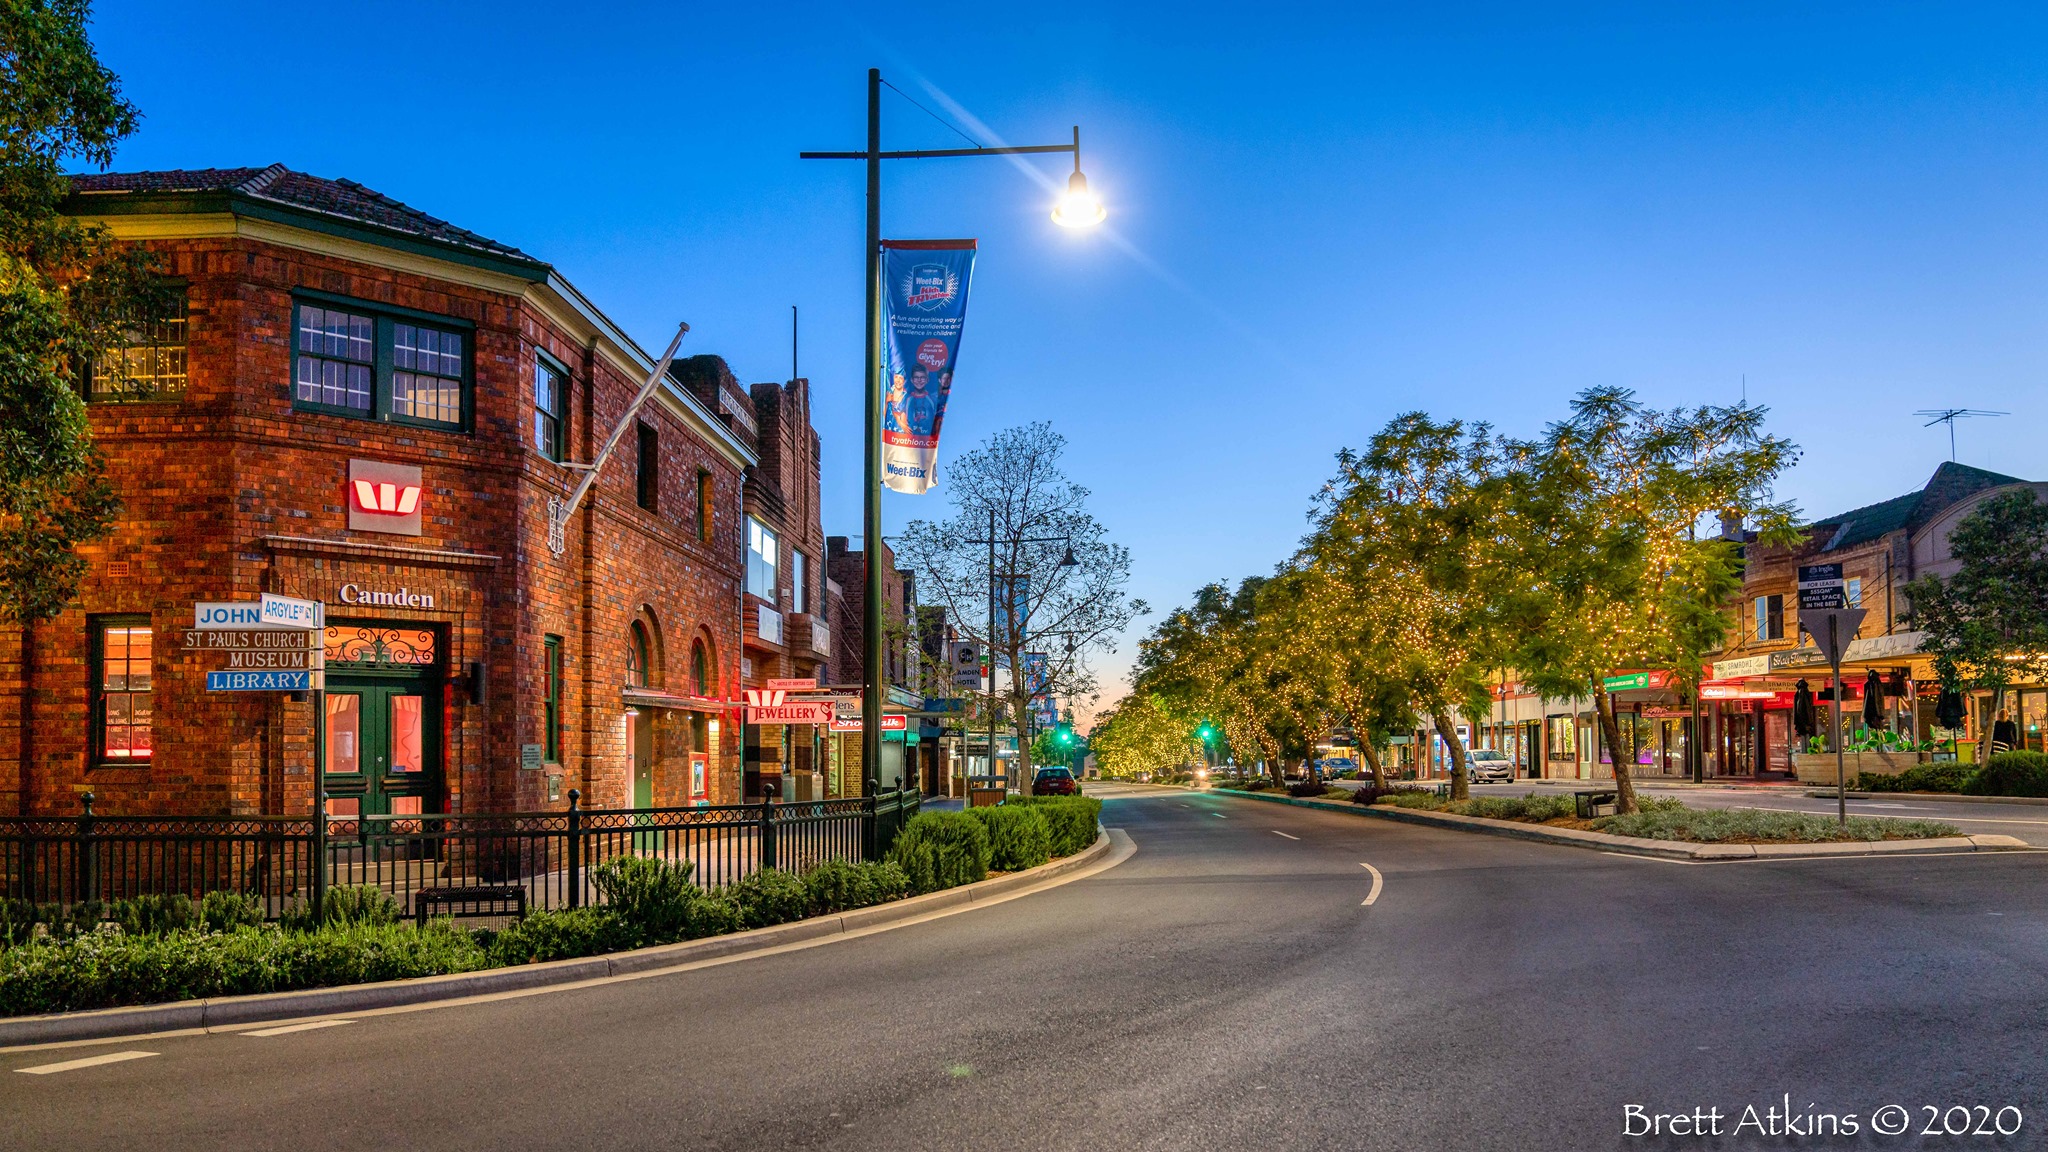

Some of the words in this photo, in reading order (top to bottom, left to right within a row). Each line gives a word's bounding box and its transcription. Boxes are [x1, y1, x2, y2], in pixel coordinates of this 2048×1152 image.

[916, 277, 943, 285] Weet-Bix
[892, 321, 916, 329] building
[921, 316, 944, 324] exciting
[918, 352, 935, 360] Give
[931, 358, 945, 367] try!
[886, 463, 927, 478] Weet-Bix
[340, 584, 434, 608] Camden
[1821, 593, 1841, 601] SPACE
[200, 609, 260, 623] JOHN
[264, 601, 299, 620] ARGYLE
[186, 632, 203, 647] ST
[208, 632, 249, 647] PAUL'S
[254, 632, 305, 648] CHURCH
[230, 652, 304, 667] MUSEUM
[1727, 660, 1752, 671] SAMADHI
[212, 672, 305, 689] LIBRARY
[754, 707, 817, 721] JEWELLERY
[836, 719, 862, 727] Sho
[880, 718, 899, 727] alk
